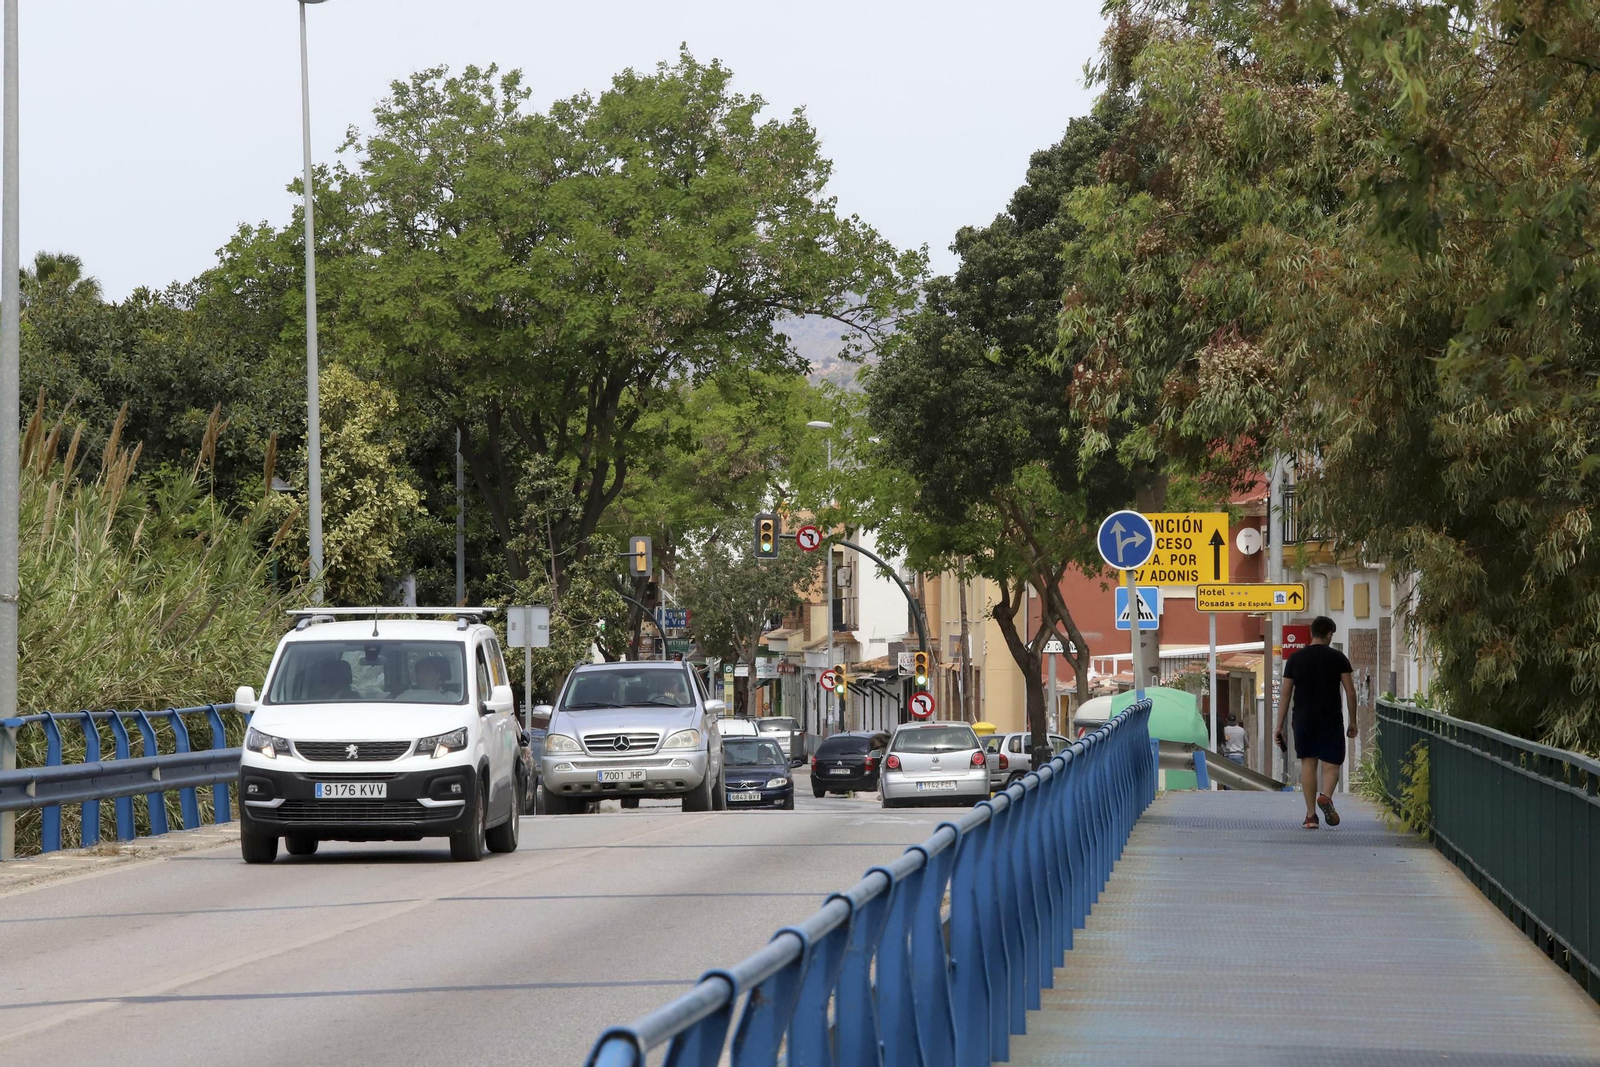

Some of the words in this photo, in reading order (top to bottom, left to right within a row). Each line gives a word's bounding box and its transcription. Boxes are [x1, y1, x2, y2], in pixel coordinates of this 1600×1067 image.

[1148, 515, 1203, 534] NCIÓN
[1156, 537, 1193, 550] CESO
[1143, 553, 1165, 566] .A.
[1170, 553, 1197, 566] POR
[1149, 569, 1199, 582] ADONIS
[1199, 588, 1226, 596] Hotel
[1247, 600, 1272, 608] España
[604, 771, 624, 780] 7001
[627, 771, 643, 780] JHP
[324, 784, 356, 796] 9176
[360, 784, 384, 796] KVV
